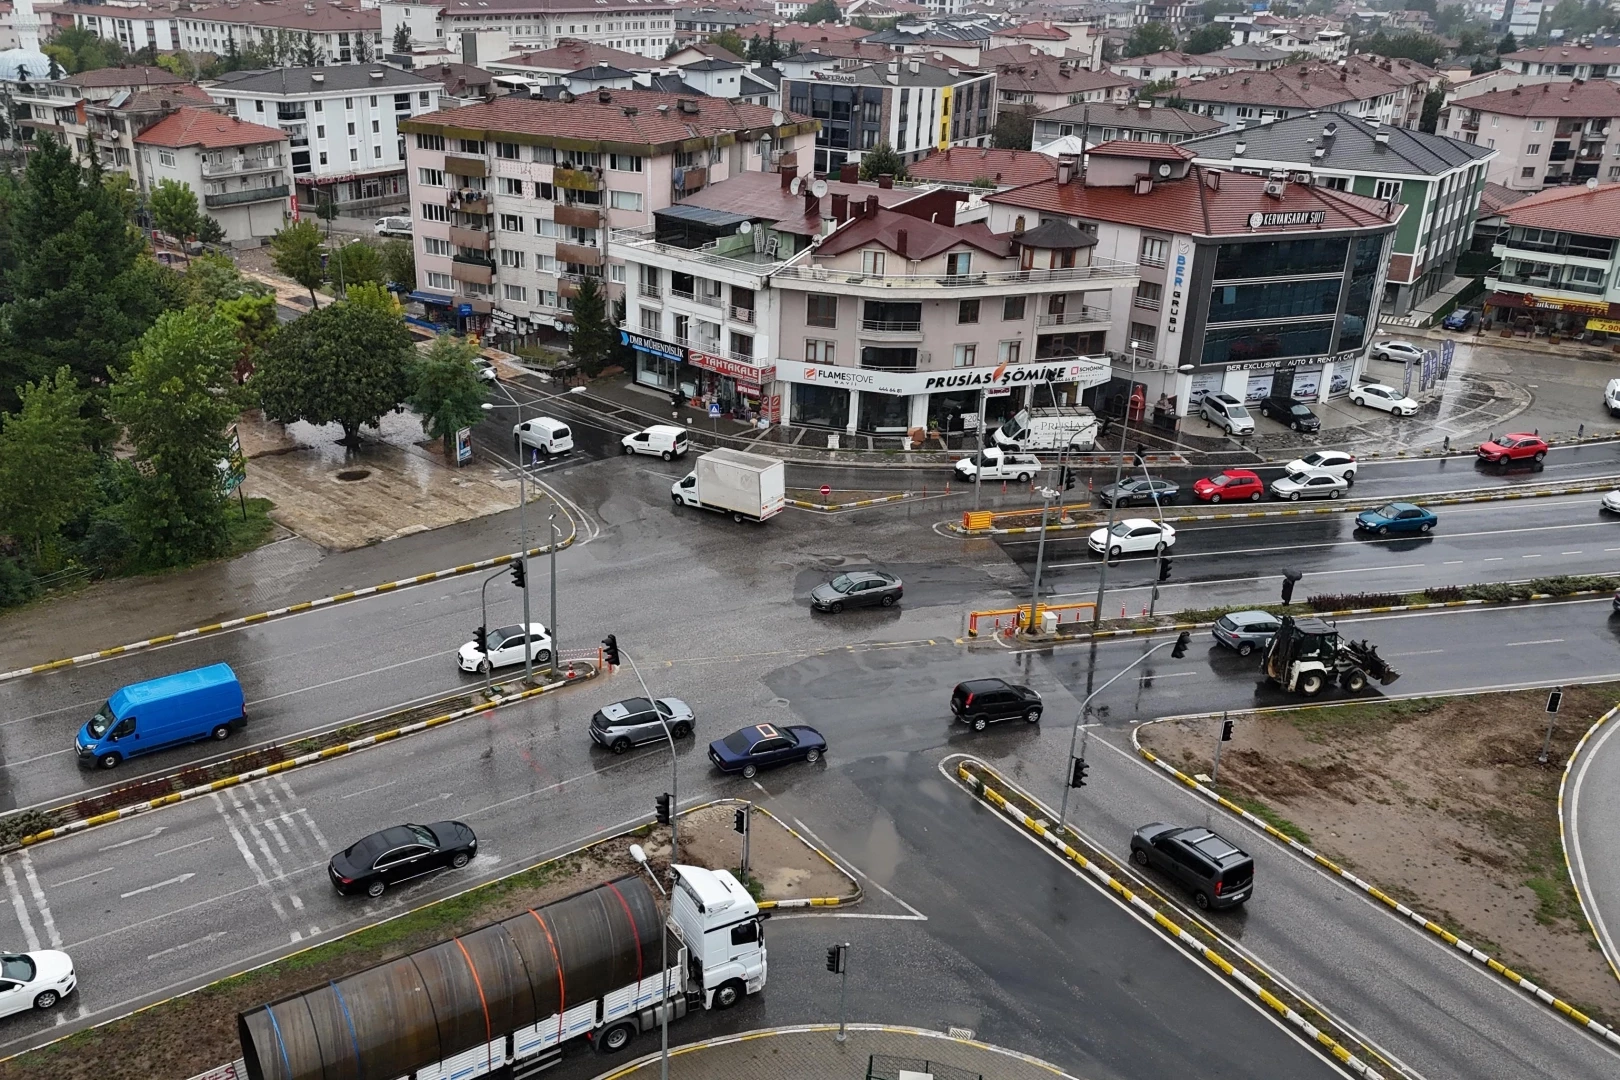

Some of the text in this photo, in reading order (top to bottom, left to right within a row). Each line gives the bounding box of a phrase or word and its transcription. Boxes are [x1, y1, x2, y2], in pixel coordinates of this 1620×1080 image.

[1263, 212, 1309, 226] KERVANSARAY
[1168, 254, 1186, 333] BER GRUBU
[629, 335, 643, 347] DMR
[643, 339, 684, 358] MÜHENDİSLİK
[704, 356, 758, 378] TAHTAKALE
[1243, 361, 1281, 370] EXCLUSIVE
[1317, 356, 1336, 364] RENT
[818, 370, 874, 384] FLAMESTOVE
[925, 371, 993, 389] PRUSİAS
